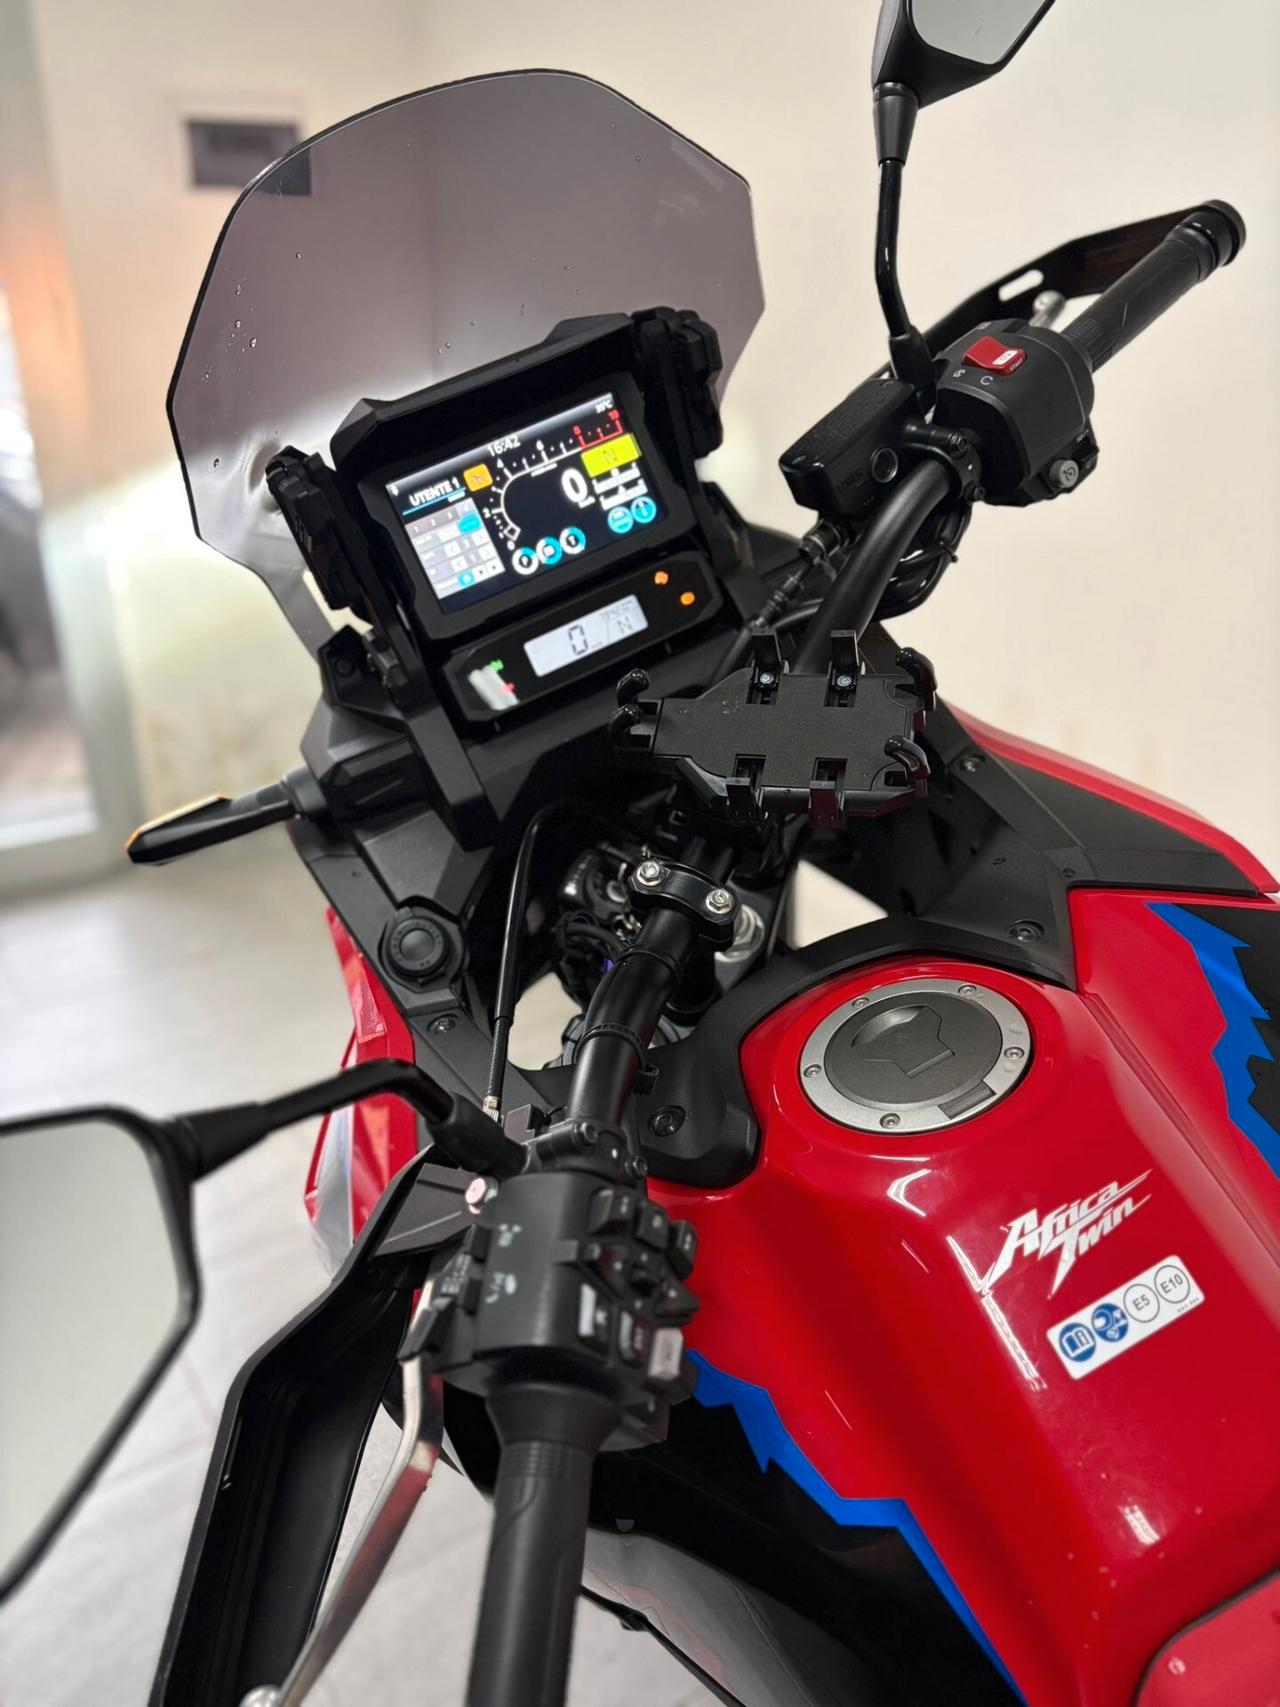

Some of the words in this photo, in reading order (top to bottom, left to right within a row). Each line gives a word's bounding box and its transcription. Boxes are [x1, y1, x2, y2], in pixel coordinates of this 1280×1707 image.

[487, 434, 521, 457] 16:42
[602, 447, 618, 464] N
[408, 480, 453, 507] UTENTE
[452, 476, 460, 489] 1
[561, 467, 588, 503] 0
[482, 507, 491, 518] 2
[567, 624, 589, 656] 0
[983, 1168, 1152, 1290] Africa
[1040, 1194, 1152, 1297] Twin
[1160, 1273, 1184, 1295] E10
[1131, 1294, 1151, 1312] E5
